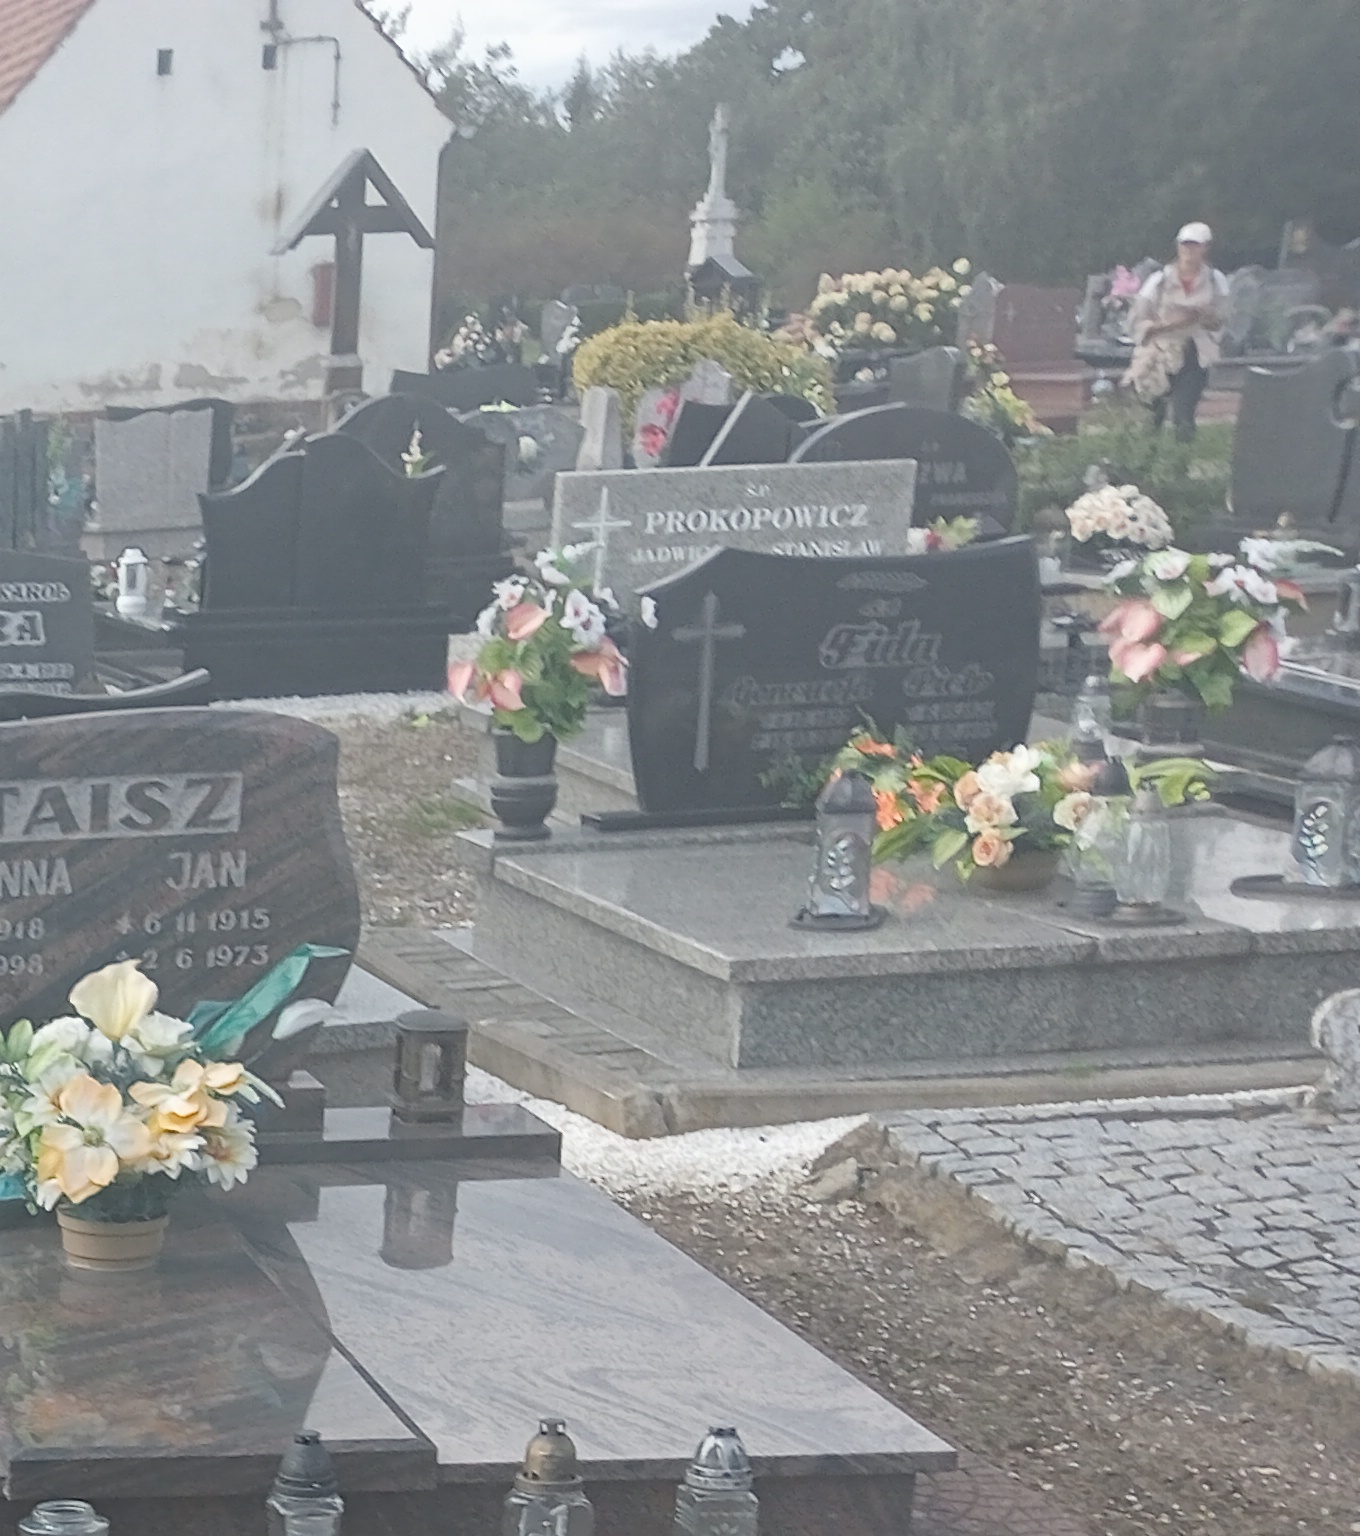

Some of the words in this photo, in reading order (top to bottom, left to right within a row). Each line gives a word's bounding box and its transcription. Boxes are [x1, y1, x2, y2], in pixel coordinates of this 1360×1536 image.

[644, 504, 869, 535] PROKOPOWICZ
[166, 850, 247, 891] JAN
[143, 913, 163, 936] 6
[207, 907, 272, 932] 1915
[174, 945, 194, 969] 6
